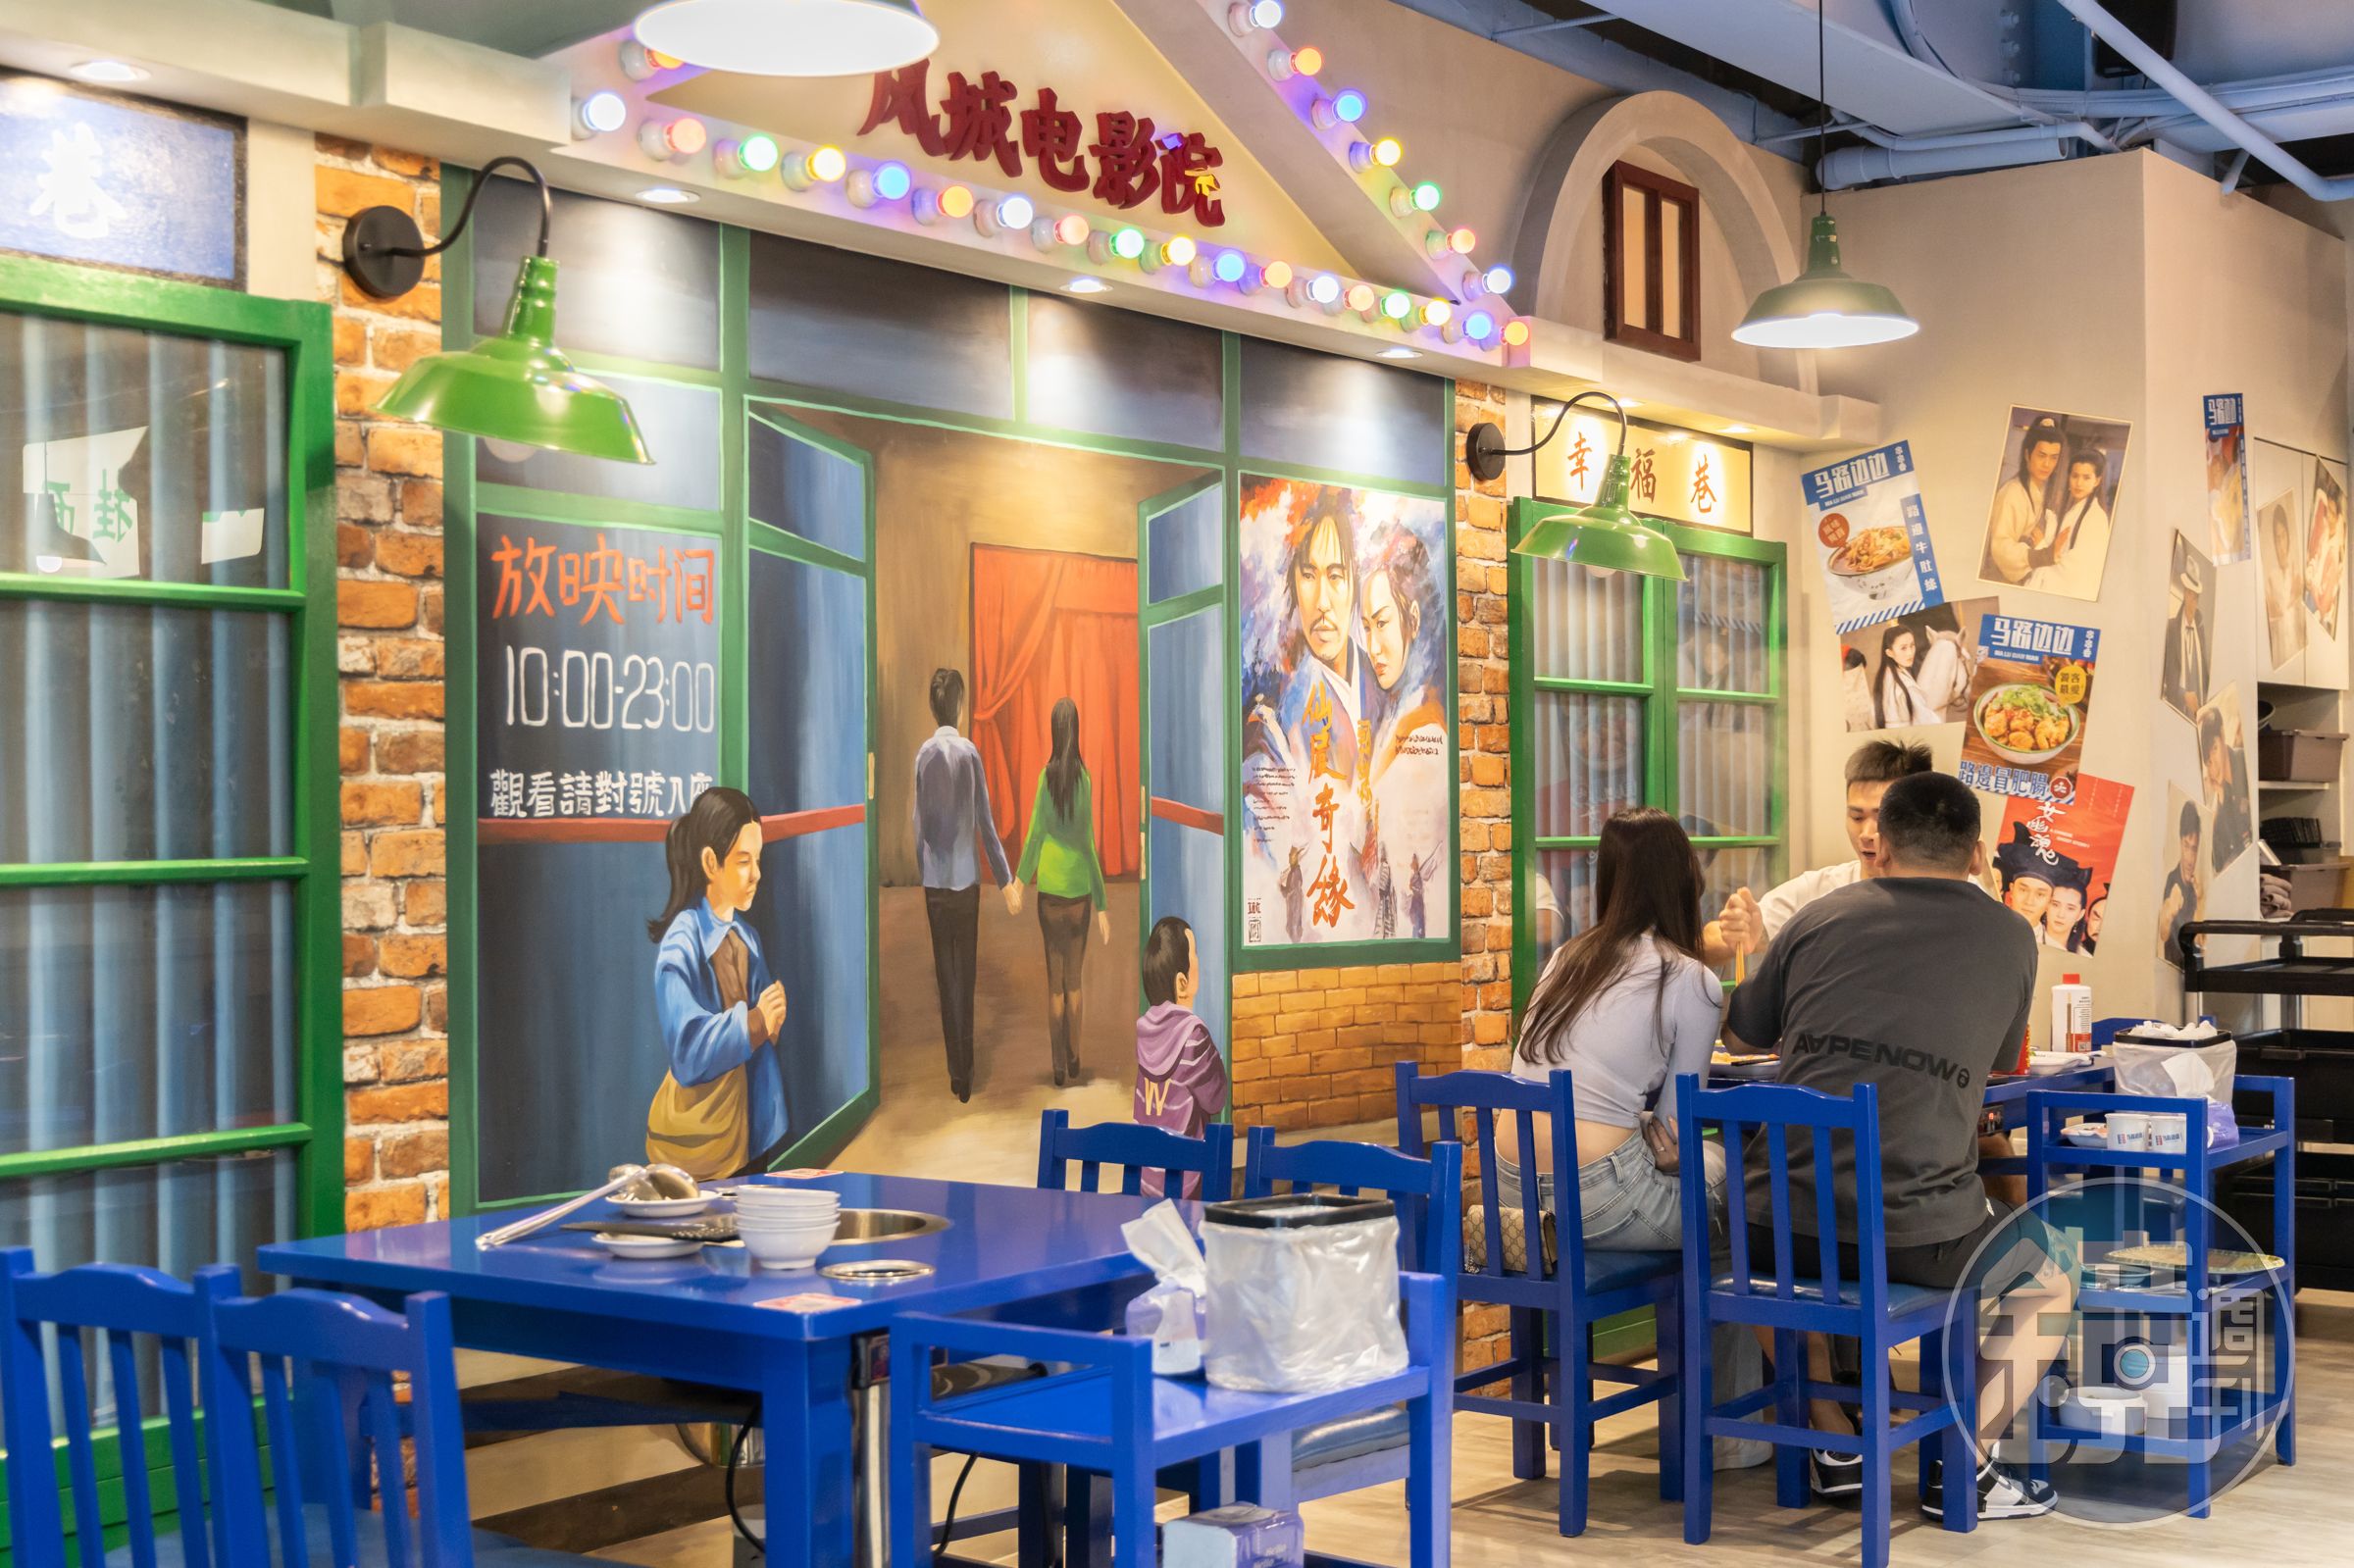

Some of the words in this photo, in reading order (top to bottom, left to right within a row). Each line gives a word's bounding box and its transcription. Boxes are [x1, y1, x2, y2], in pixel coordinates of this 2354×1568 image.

[856, 58, 1226, 228] 风城电影院
[491, 532, 715, 626] 放映时间
[1990, 617, 2074, 655] 马路边边
[506, 645, 715, 733] 10:00-23:00
